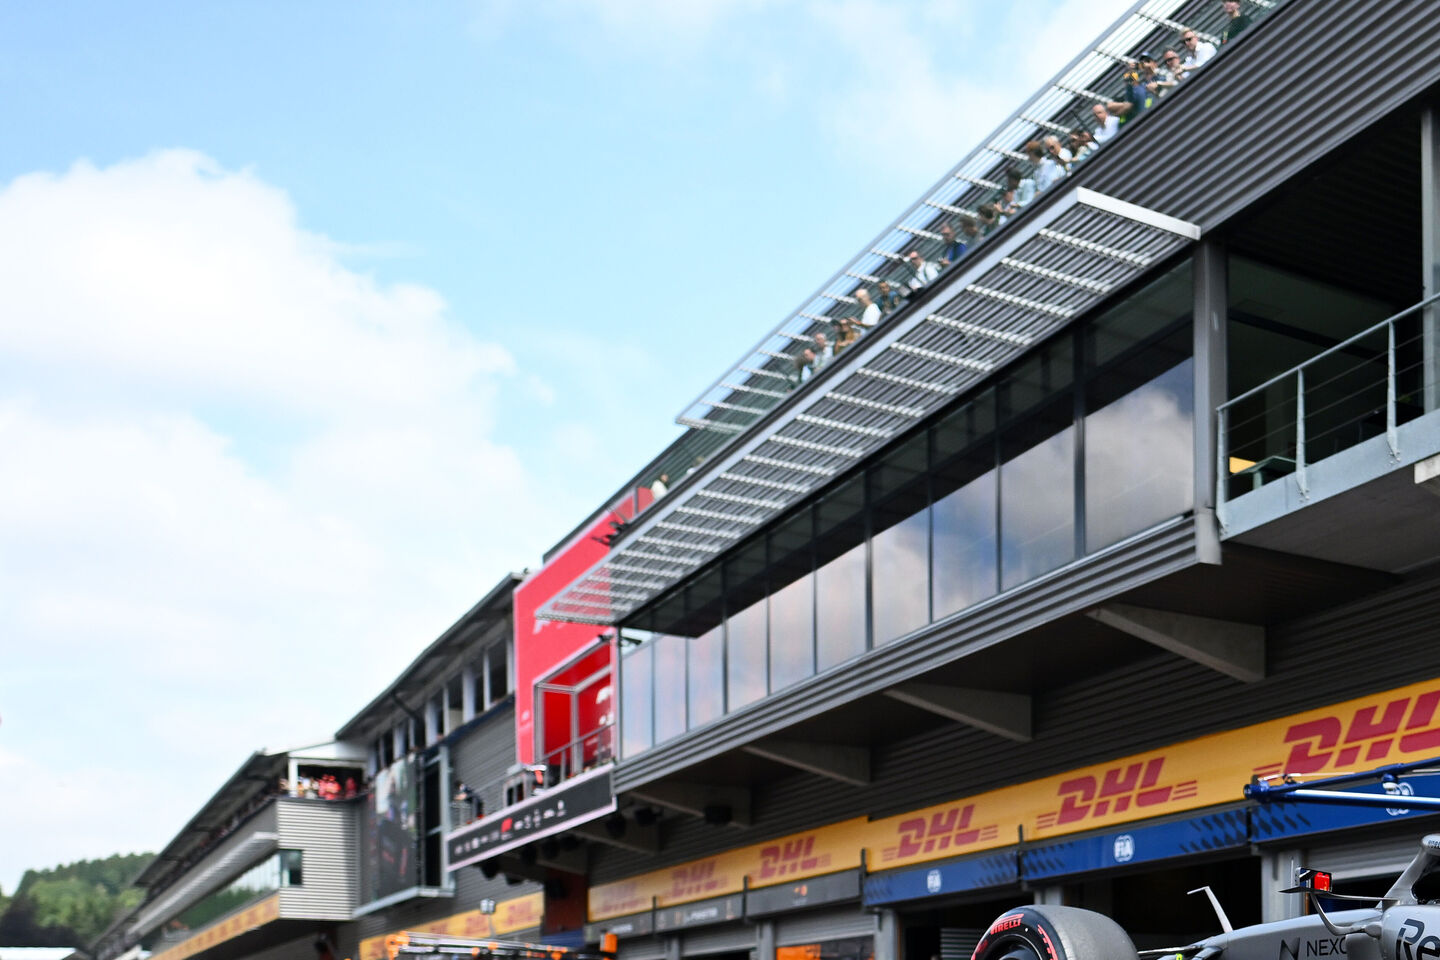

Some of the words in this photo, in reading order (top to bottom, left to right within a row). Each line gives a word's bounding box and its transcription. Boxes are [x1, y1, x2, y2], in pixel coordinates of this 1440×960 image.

[1057, 756, 1174, 825] DHL
[897, 804, 981, 859] DHL
[759, 835, 818, 879] DHL
[990, 913, 1025, 935] PIRELLI
